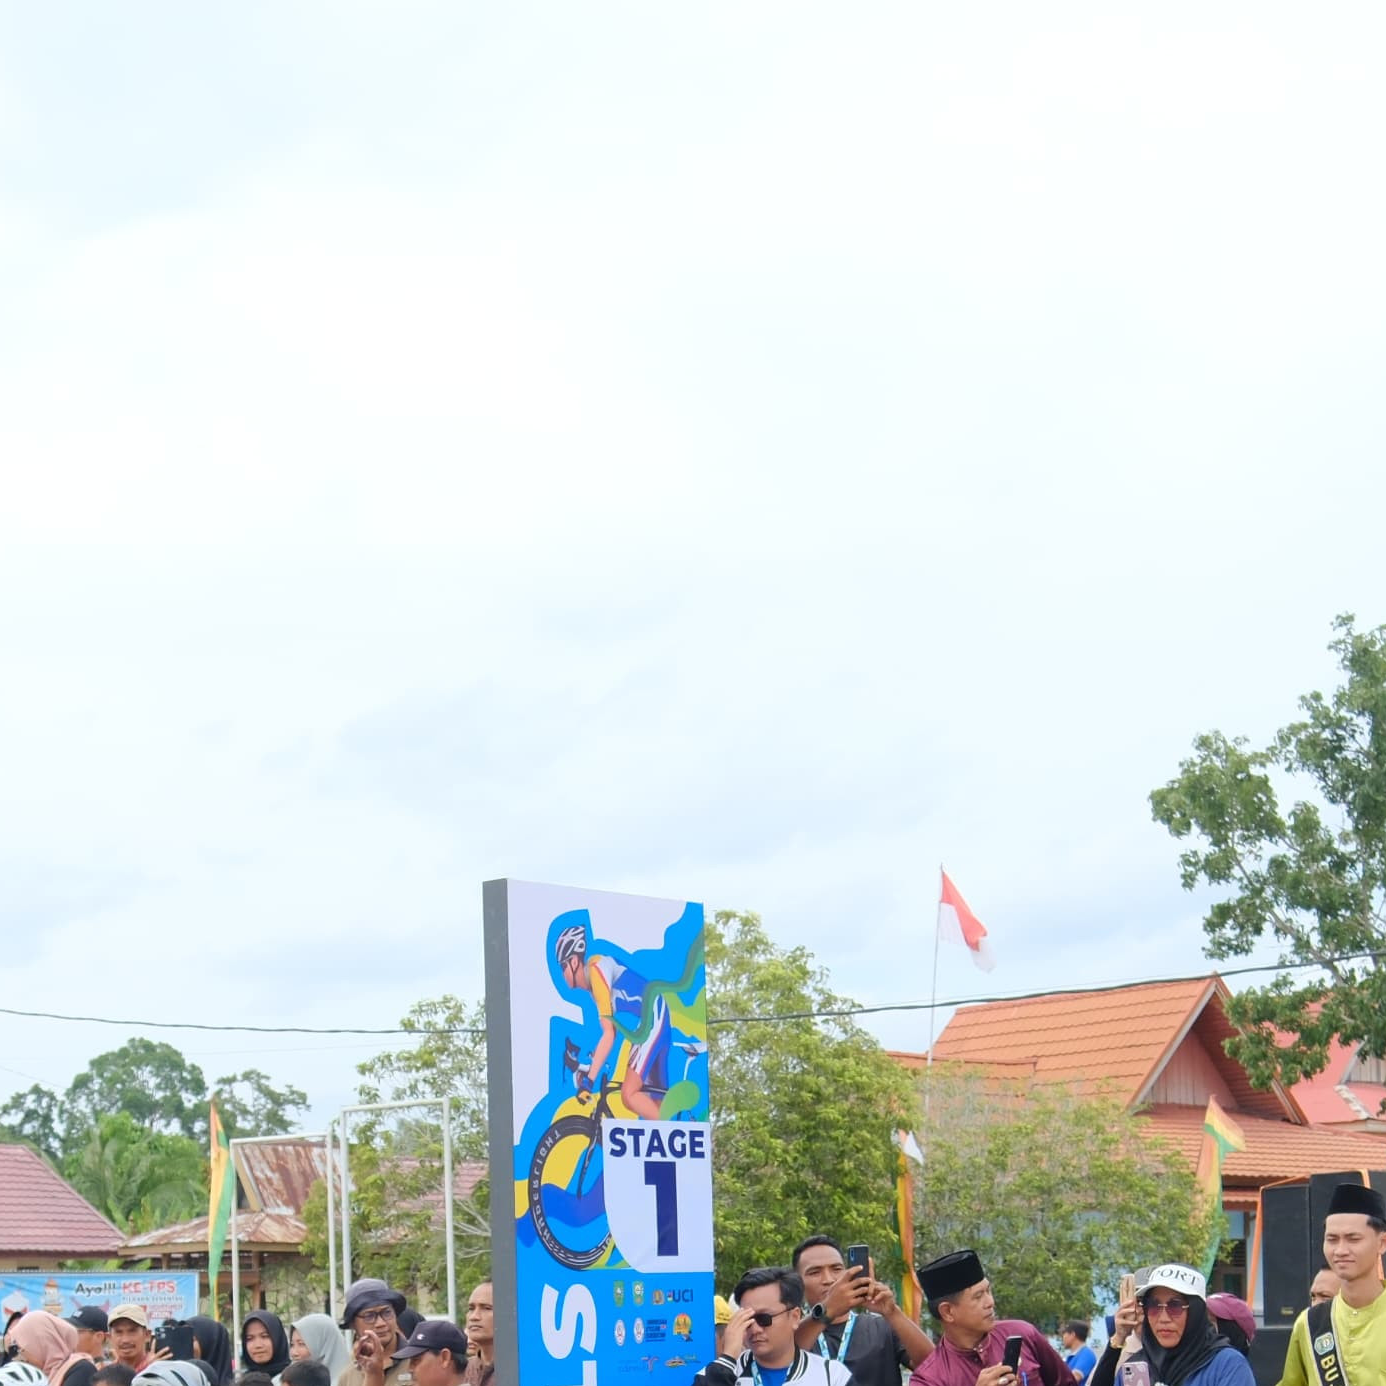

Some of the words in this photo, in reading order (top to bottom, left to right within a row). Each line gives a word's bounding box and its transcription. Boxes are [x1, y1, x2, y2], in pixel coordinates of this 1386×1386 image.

[609, 1126, 705, 1159] STAGE
[644, 1160, 679, 1258] 1
[672, 1289, 694, 1302] UCI
